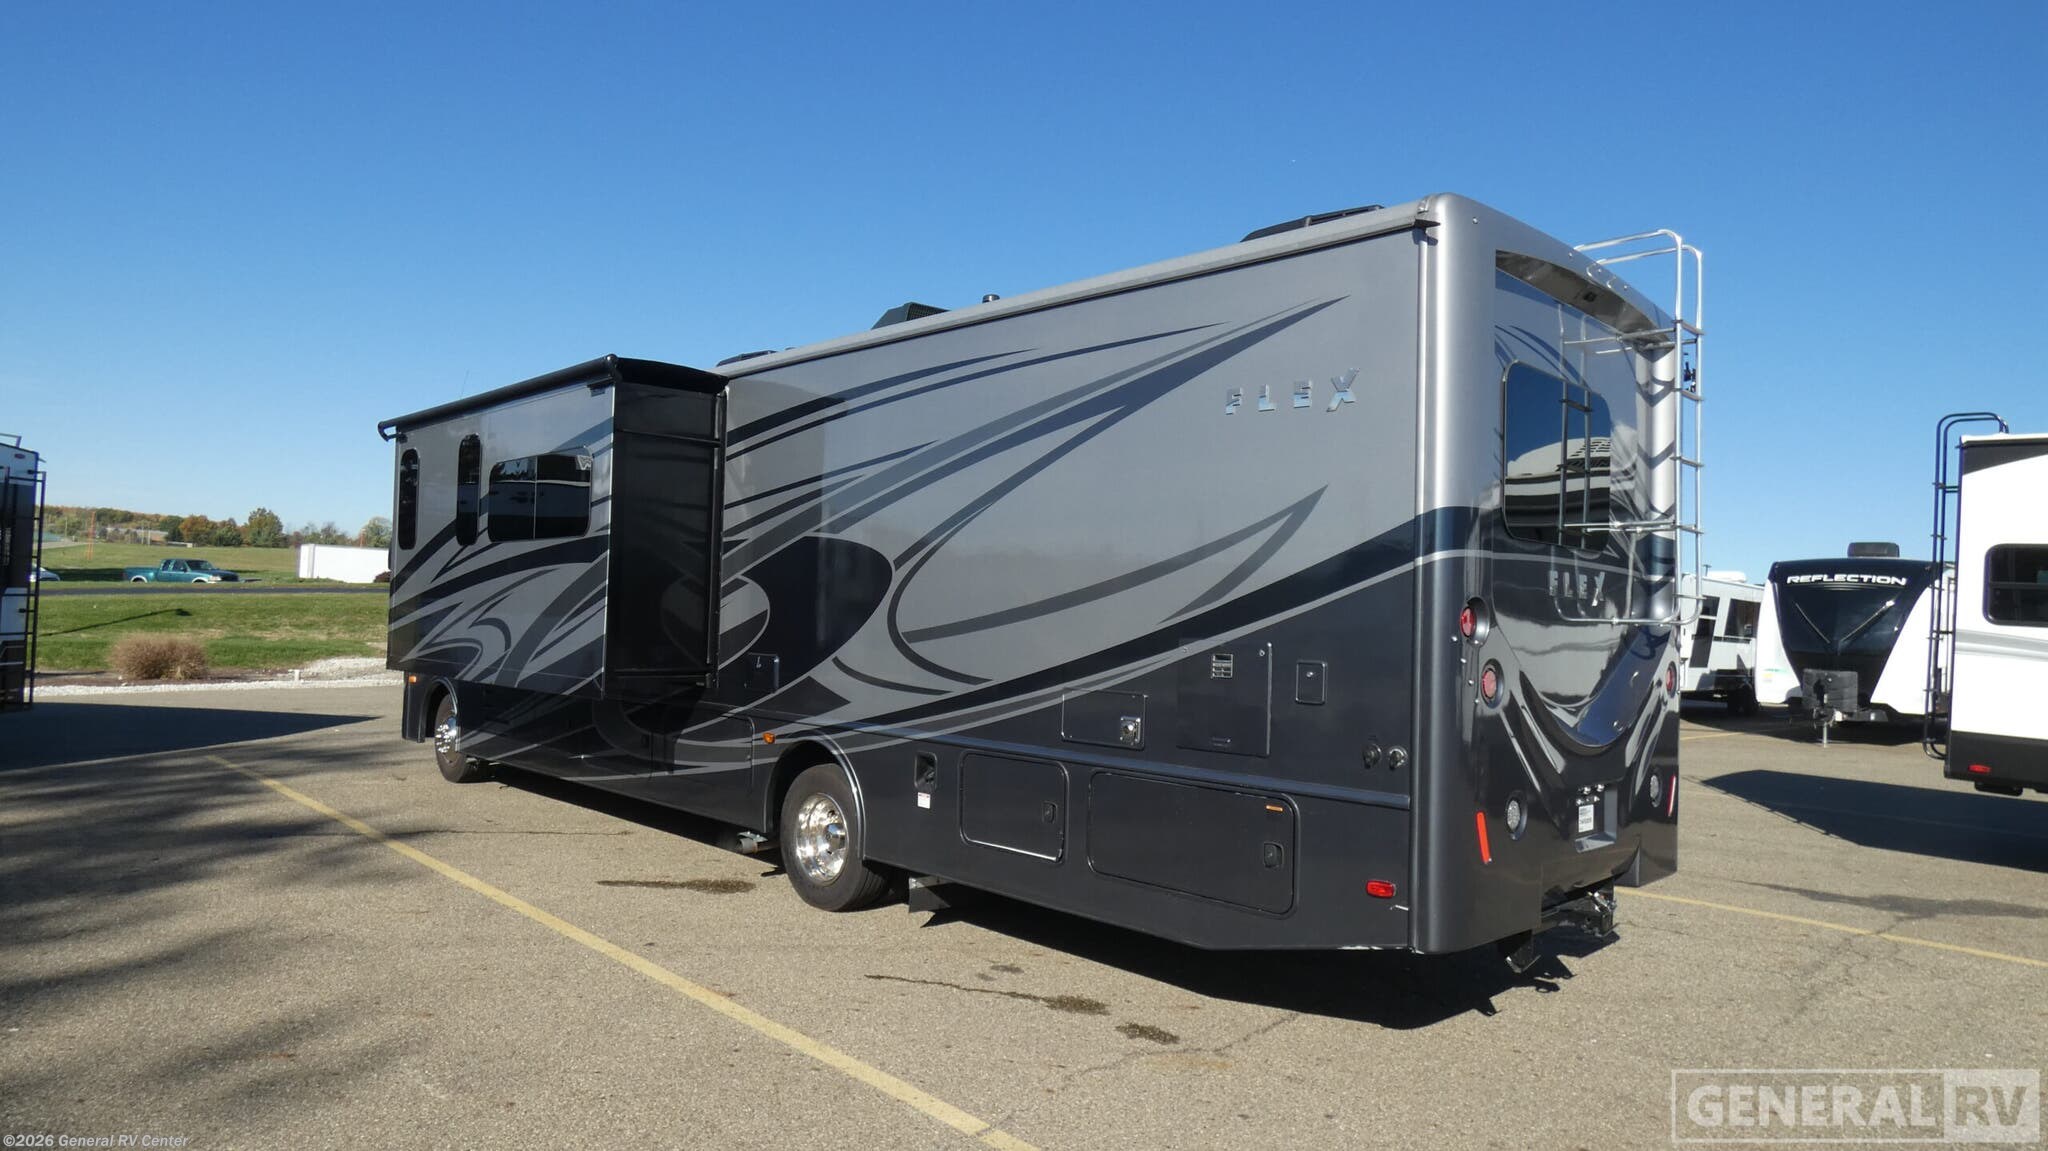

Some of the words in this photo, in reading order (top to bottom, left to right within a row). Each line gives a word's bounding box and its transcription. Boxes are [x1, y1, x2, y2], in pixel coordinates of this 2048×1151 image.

[1225, 367, 1360, 415] FLEX
[1549, 570, 1605, 607] FLEX
[1786, 574, 1907, 586] REFLECTION
